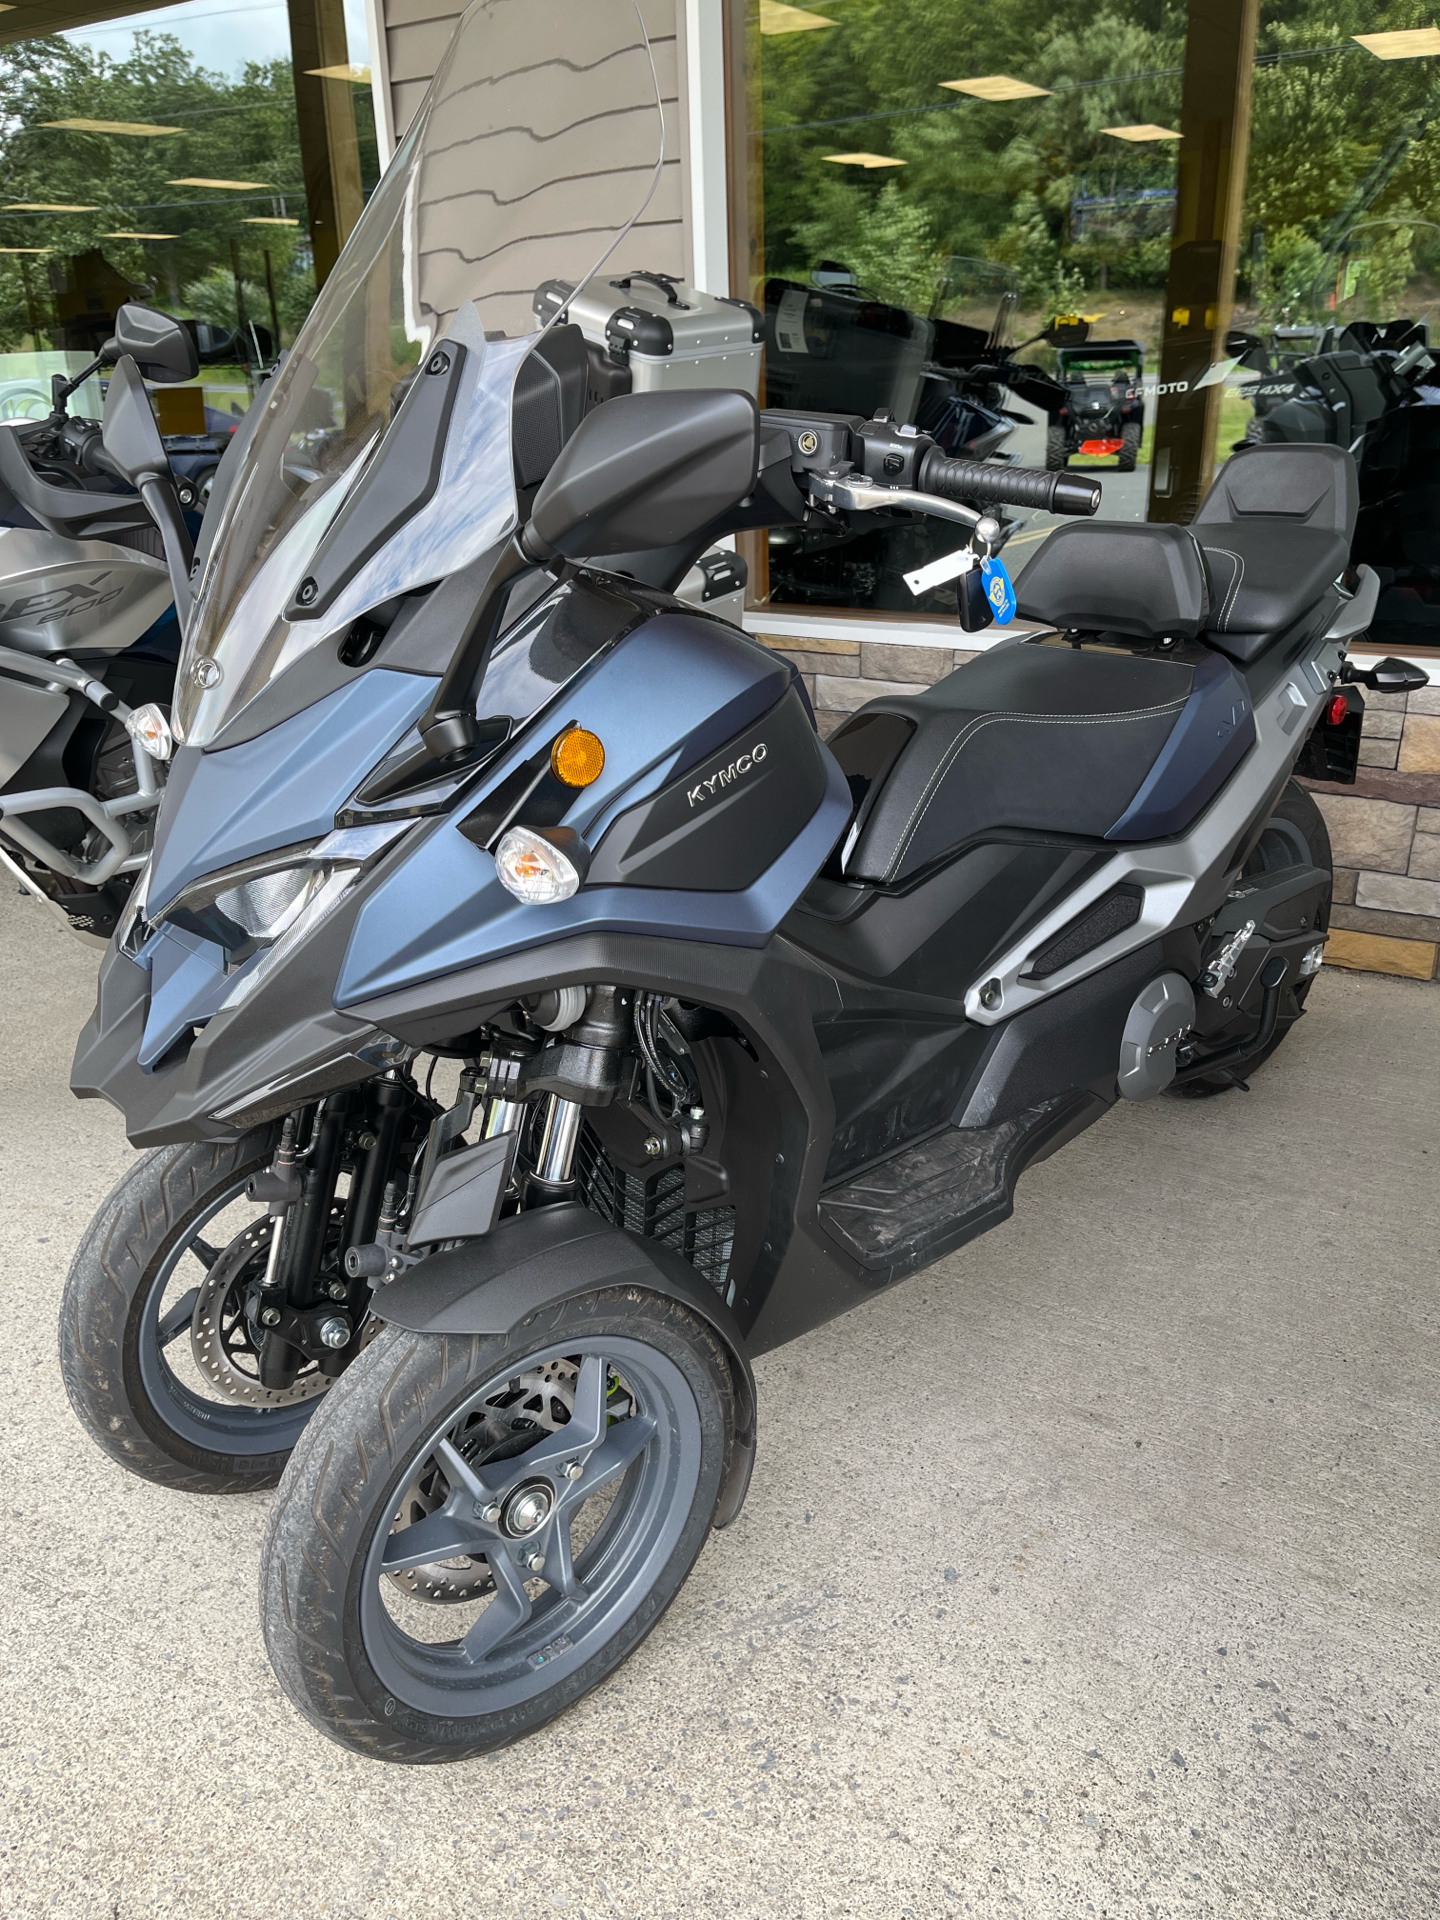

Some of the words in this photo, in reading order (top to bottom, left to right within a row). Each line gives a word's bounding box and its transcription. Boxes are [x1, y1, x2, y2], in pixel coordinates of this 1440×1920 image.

[1125, 381, 1189, 398] CFMOTO
[1259, 383, 1297, 396] 4X4
[686, 743, 769, 808] KYMCO
